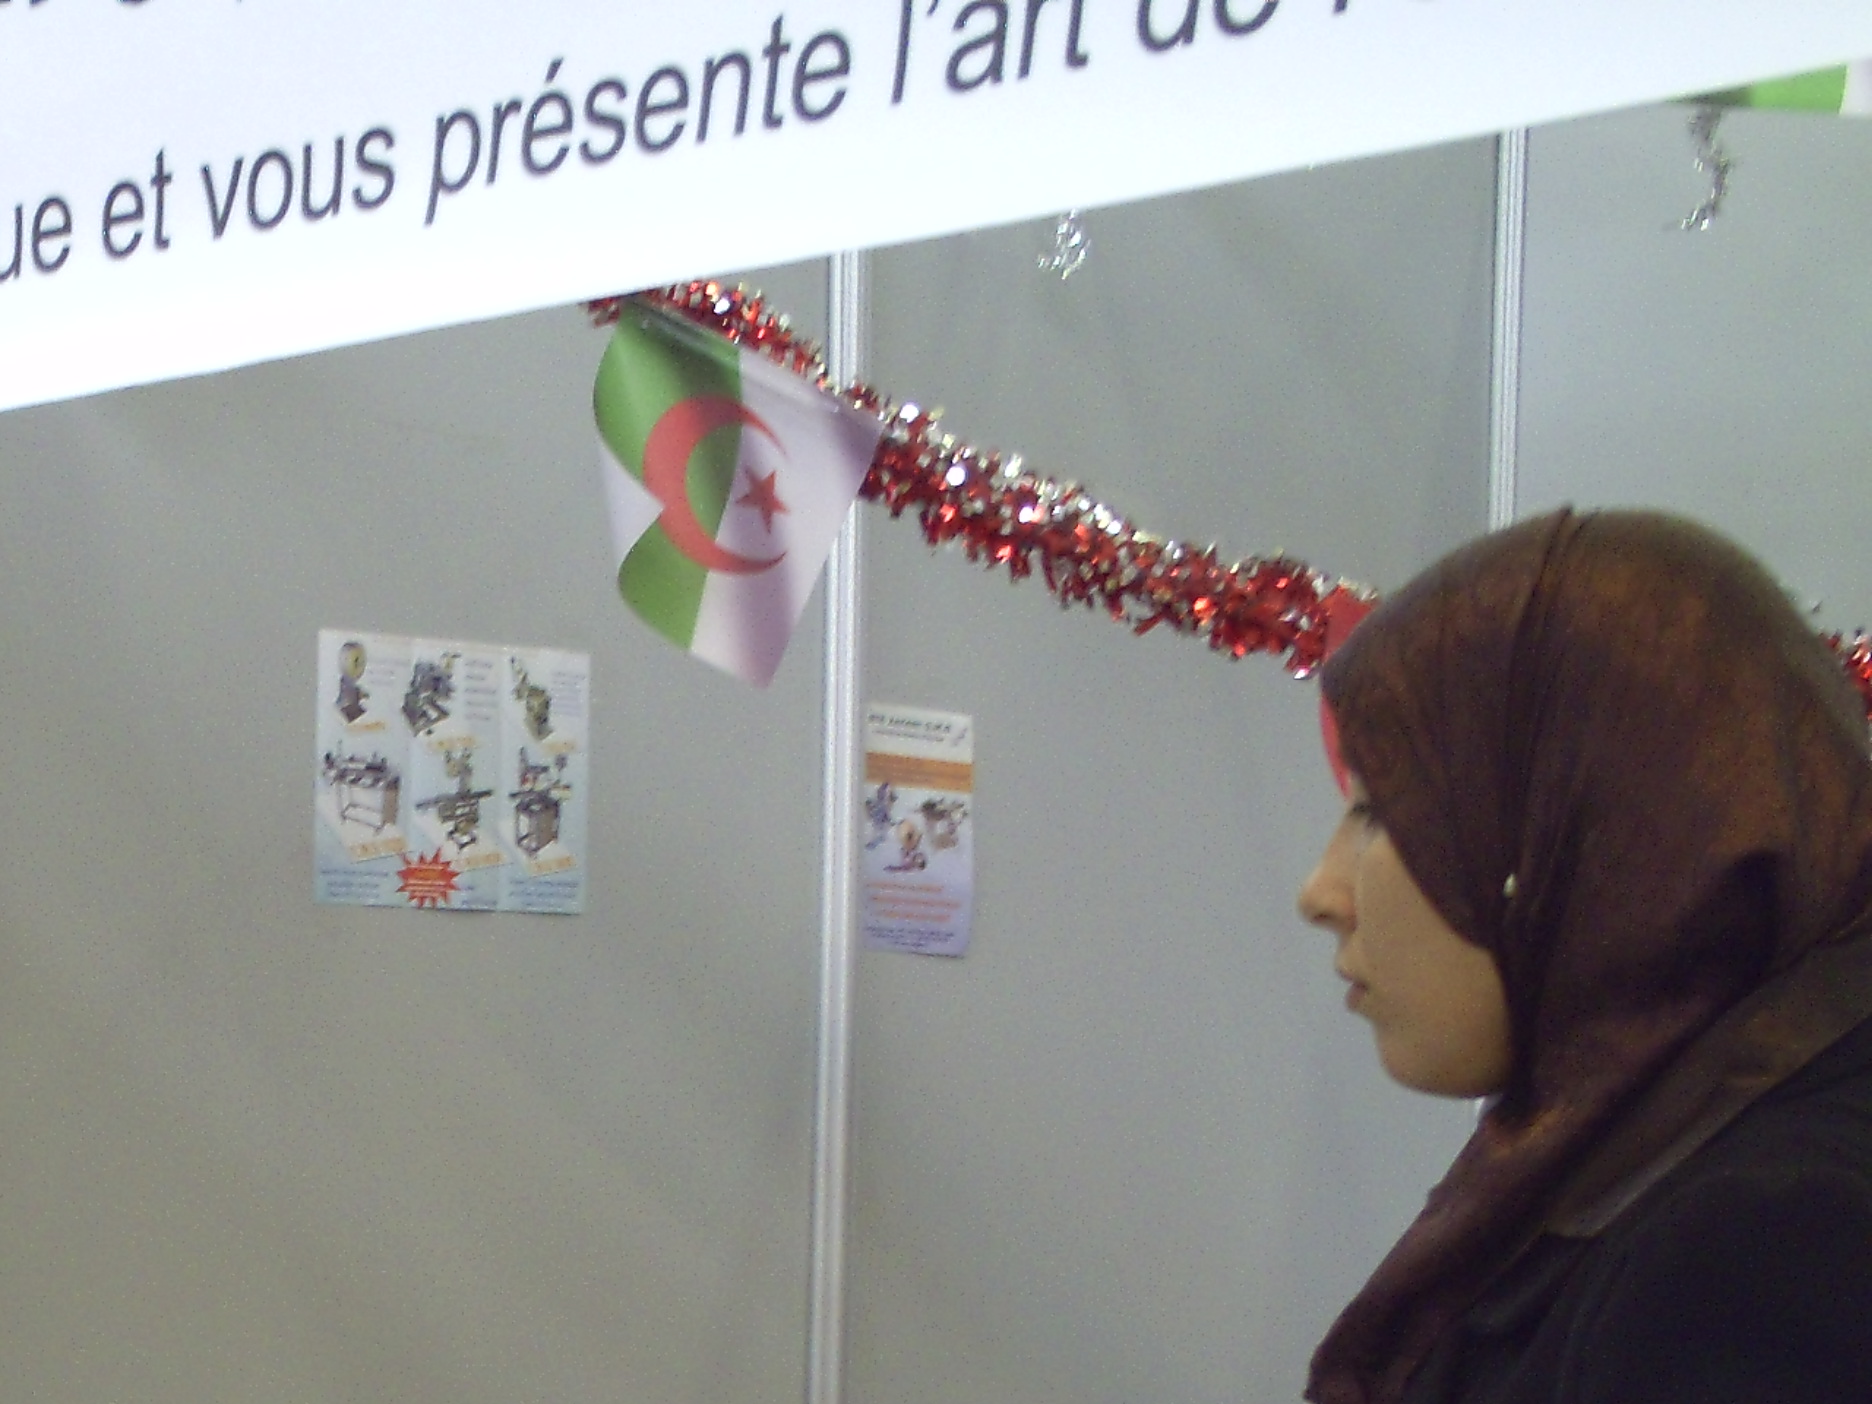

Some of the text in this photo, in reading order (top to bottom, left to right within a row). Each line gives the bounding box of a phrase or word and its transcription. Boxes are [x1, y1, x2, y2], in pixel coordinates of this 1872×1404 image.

[102, 150, 173, 259] et
[201, 127, 396, 237] vous
[425, 16, 852, 224] présente
